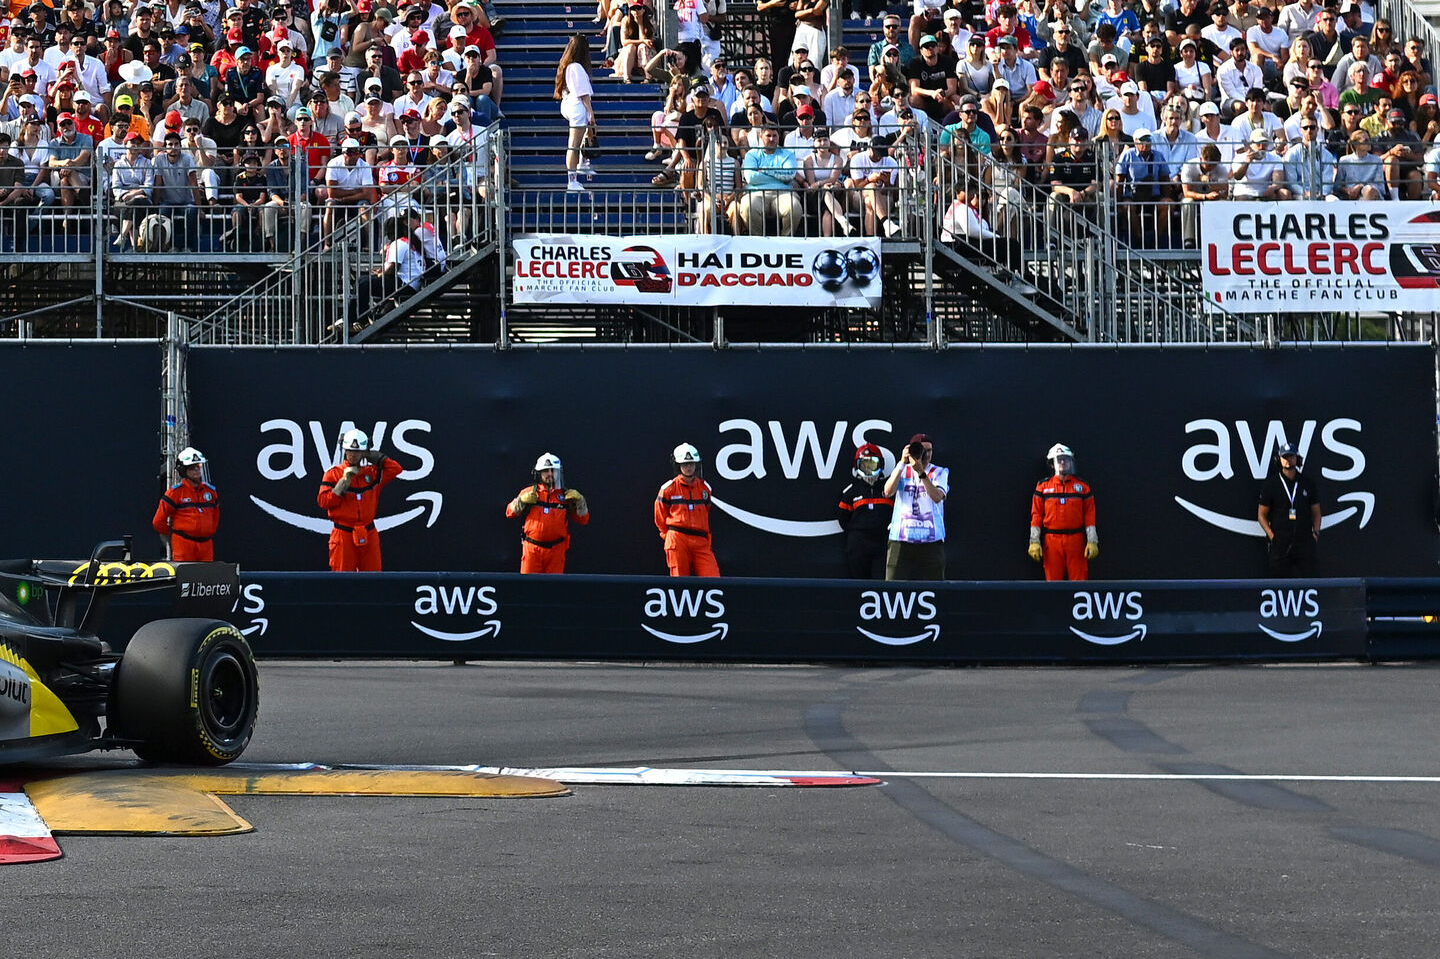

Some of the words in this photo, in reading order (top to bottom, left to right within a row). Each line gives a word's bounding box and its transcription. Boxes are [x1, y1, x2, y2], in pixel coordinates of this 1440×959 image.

[1232, 213, 1389, 240] CHARLES
[530, 246, 611, 260] CHARLES
[677, 252, 733, 269] HAI
[740, 254, 804, 269] DUE
[1208, 243, 1386, 275] LECLERC
[517, 261, 608, 278] LECLERC
[677, 272, 813, 288] D'ACCIAIO
[1249, 279, 1281, 288] THE
[1291, 279, 1374, 288] OFFICIAL
[1225, 290, 1299, 301] MARCHE
[1310, 290, 1342, 300] FAN
[1354, 289, 1398, 299] CLUB
[32, 585, 43, 598] bp
[191, 582, 231, 597] Libertex
[415, 586, 497, 616] aws
[645, 589, 724, 618] aws
[860, 591, 936, 620] aws
[1073, 592, 1142, 620] aws
[1260, 589, 1319, 618] aws
